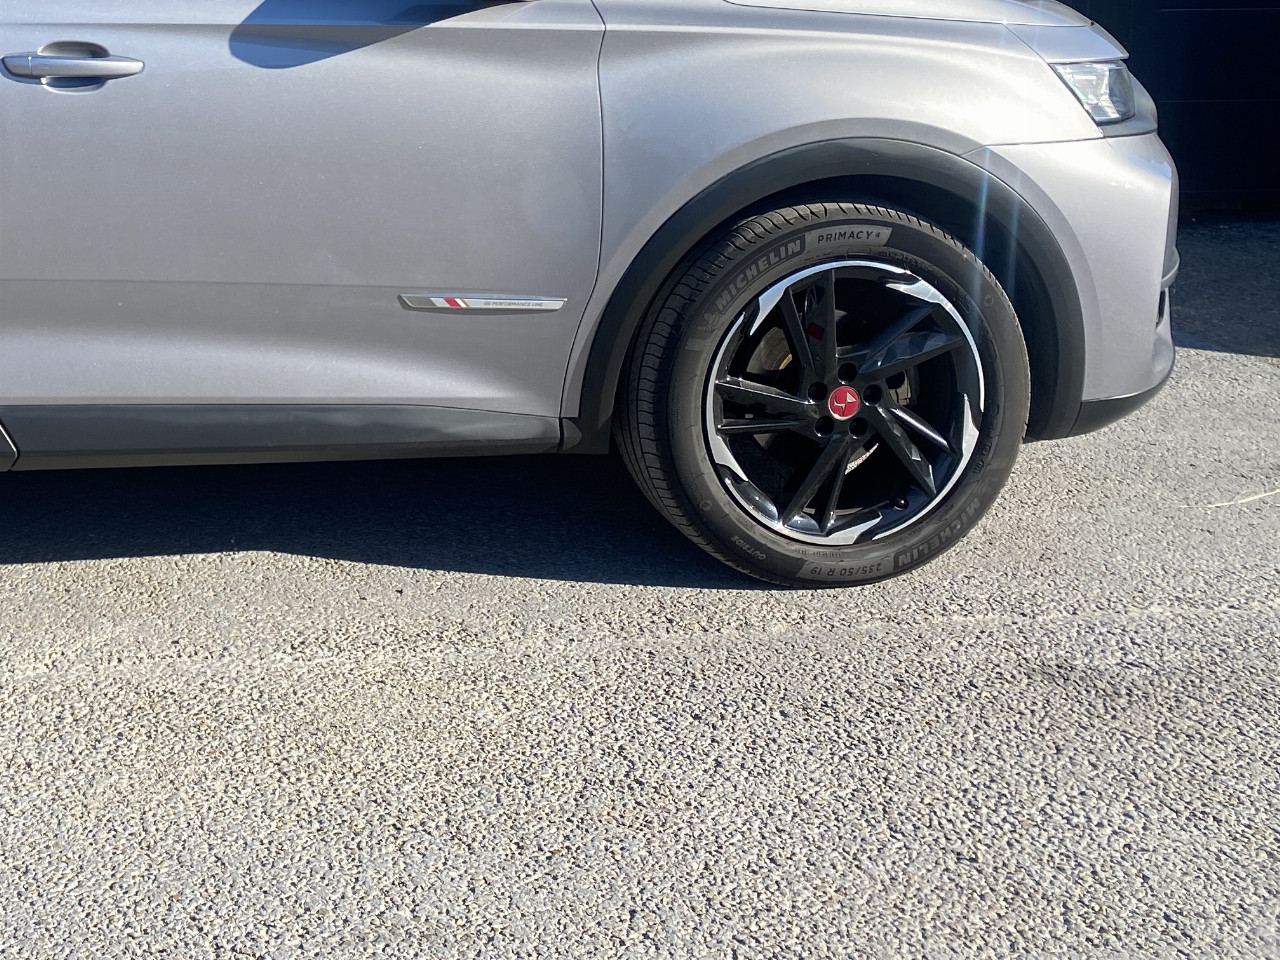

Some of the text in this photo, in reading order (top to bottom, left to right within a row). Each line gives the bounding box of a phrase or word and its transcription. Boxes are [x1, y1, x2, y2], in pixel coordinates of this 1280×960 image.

[715, 239, 802, 308] MICHELIN
[818, 231, 873, 244] PRIMACY
[731, 535, 767, 560] OUTSIDE
[898, 497, 981, 567] MICHELIN
[839, 562, 883, 577] 235/50
